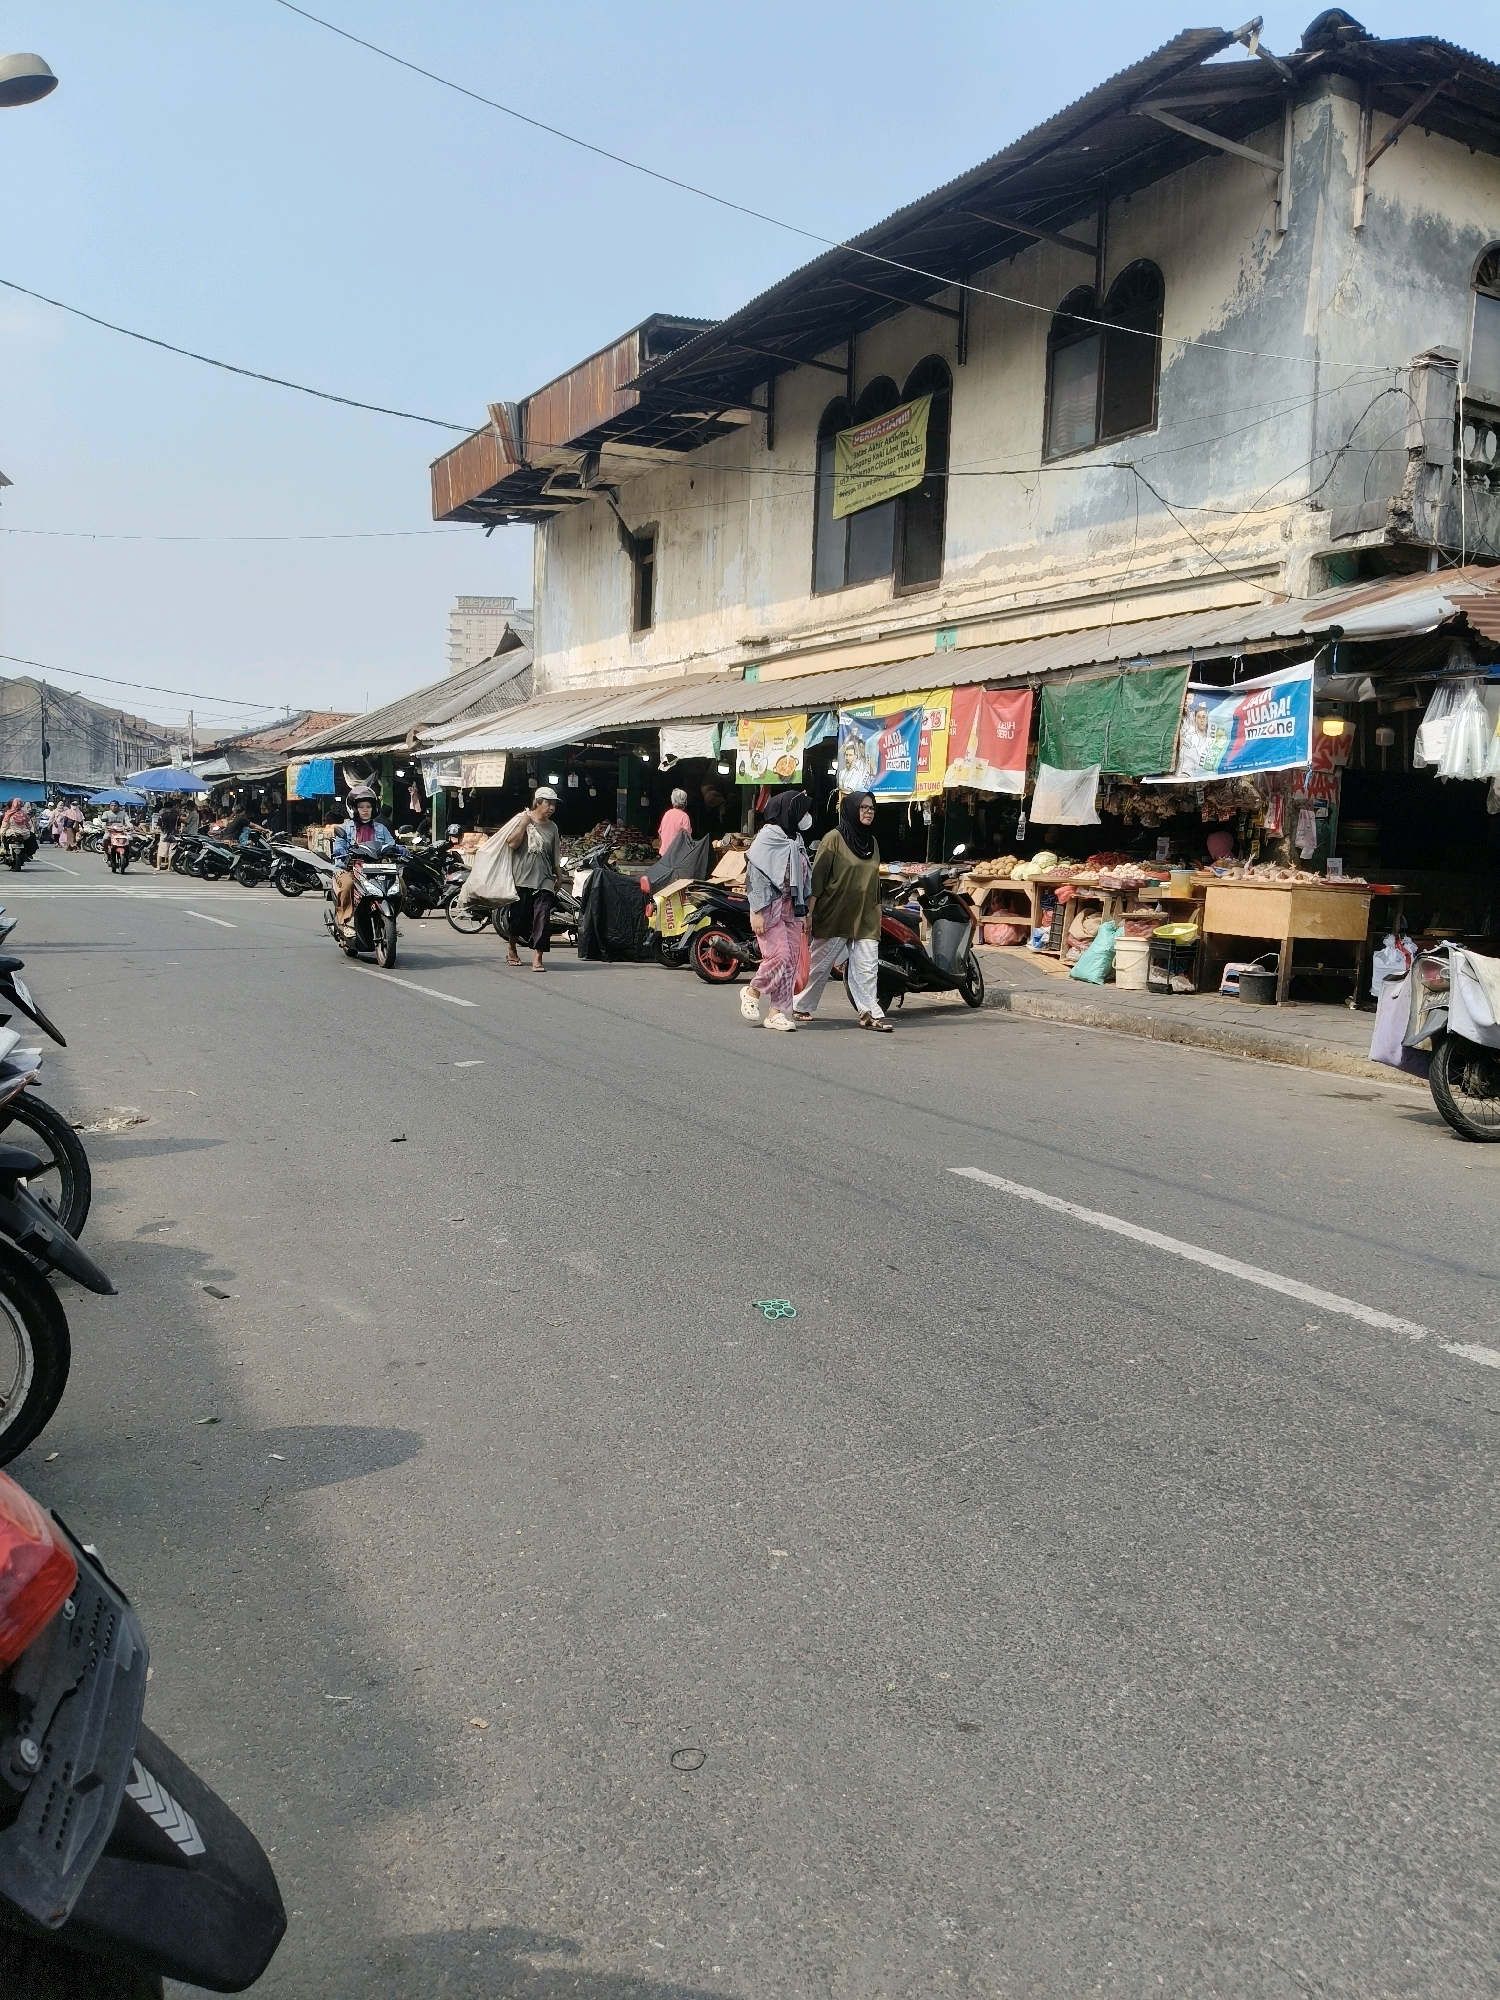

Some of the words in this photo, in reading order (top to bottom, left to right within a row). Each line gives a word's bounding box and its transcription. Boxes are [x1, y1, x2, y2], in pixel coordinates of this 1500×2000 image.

[1243, 695, 1292, 727] JUARA!
[997, 729, 1015, 740] SERU
[1246, 721, 1293, 739] mizone
